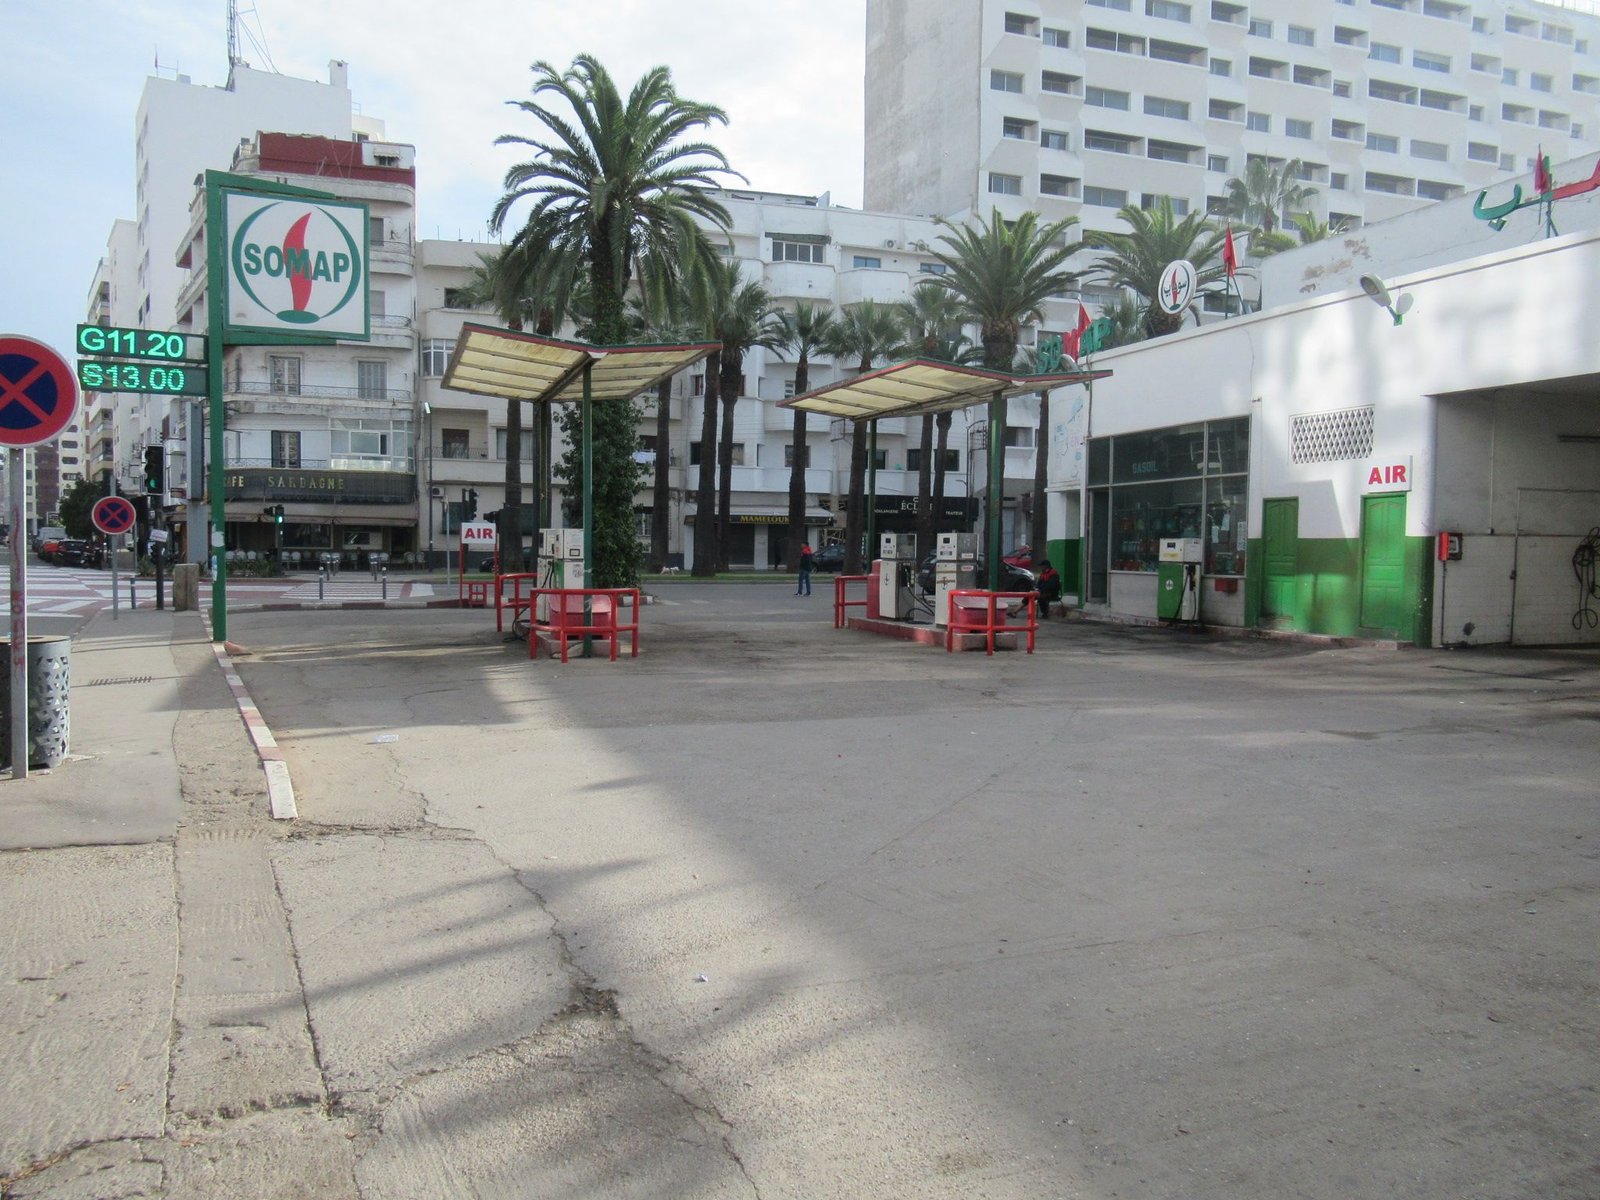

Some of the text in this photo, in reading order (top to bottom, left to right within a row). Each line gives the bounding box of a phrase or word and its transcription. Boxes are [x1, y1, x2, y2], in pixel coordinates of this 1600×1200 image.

[243, 243, 350, 283] SOMAP
[80, 327, 184, 358] G11.20
[82, 363, 185, 391] S13.00
[1368, 465, 1407, 485] AIR
[464, 527, 493, 539] AIR
